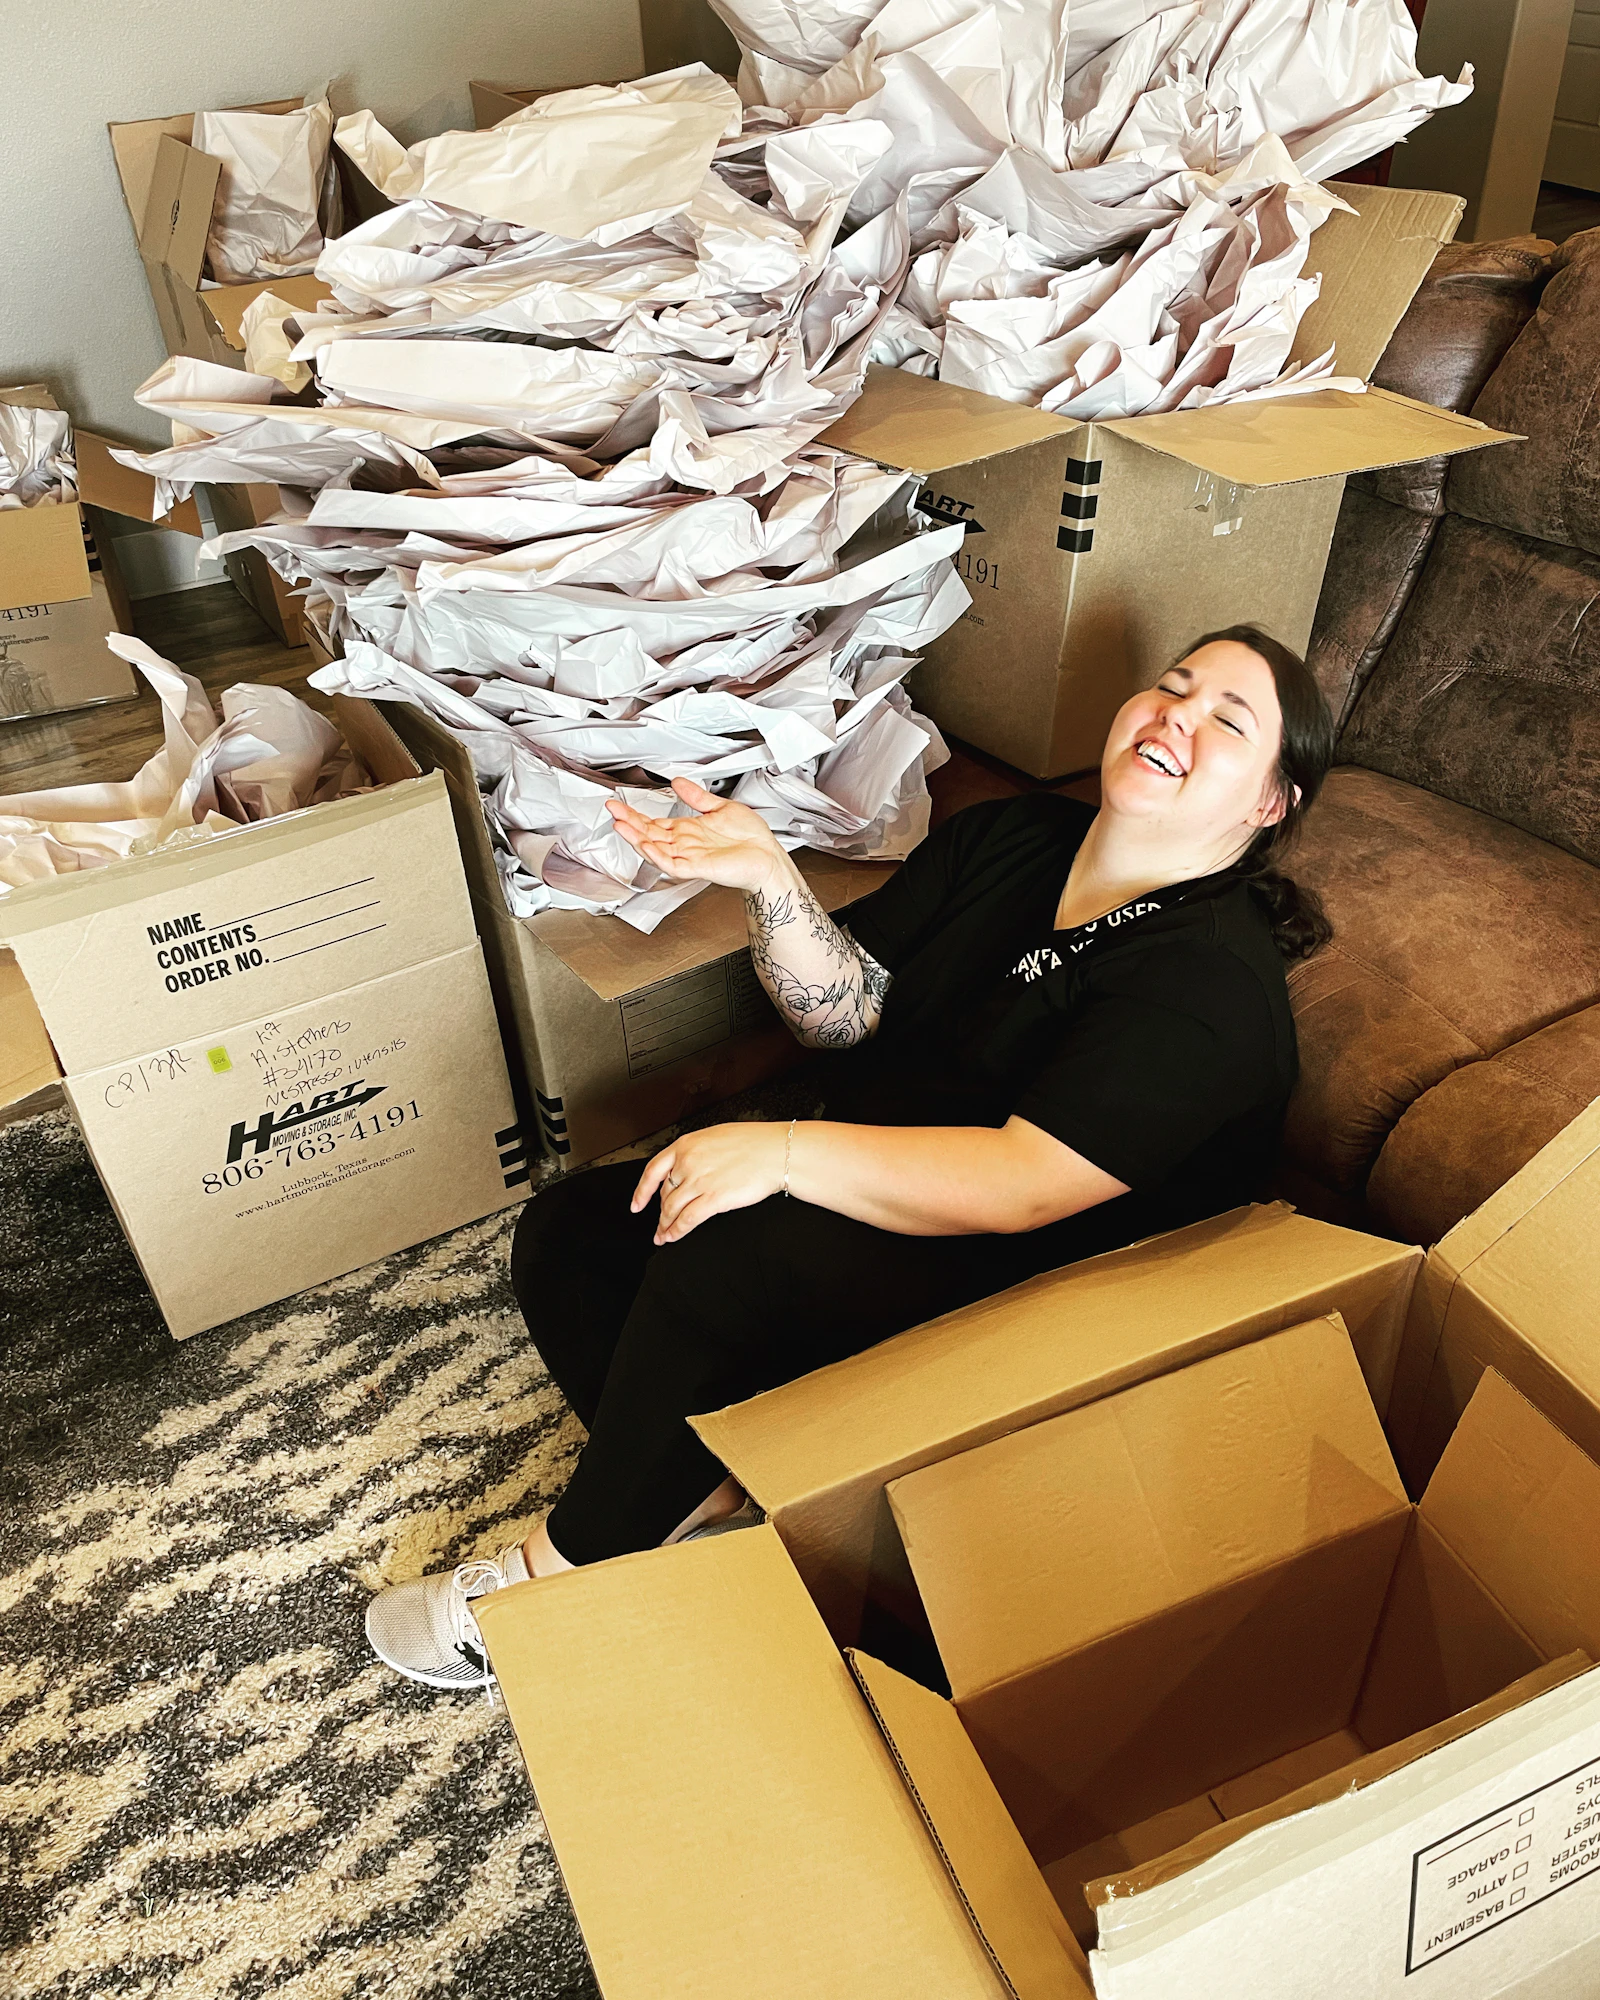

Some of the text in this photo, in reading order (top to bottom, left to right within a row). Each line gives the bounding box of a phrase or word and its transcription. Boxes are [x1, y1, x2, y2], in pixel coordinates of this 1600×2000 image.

[917, 489, 975, 516] ART
[961, 611, 985, 626] e.com
[146, 912, 206, 945] NAME
[157, 924, 257, 969] CONTENTS
[165, 948, 270, 993] ORDER NO.
[1025, 951, 1062, 983] IN A
[226, 1078, 366, 1165] HART
[272, 1108, 358, 1149] MOVING & STORAGE, INC.
[201, 1099, 424, 1195] 806-763-4191
[235, 1147, 416, 1219] www.hartmovingandstorage.com
[281, 1156, 368, 1193] Lubbock, Texas
[1447, 1847, 1511, 1890] GARAGE
[1466, 1874, 1508, 1904] ATTIC
[1424, 1899, 1505, 1953] BASEMENT
